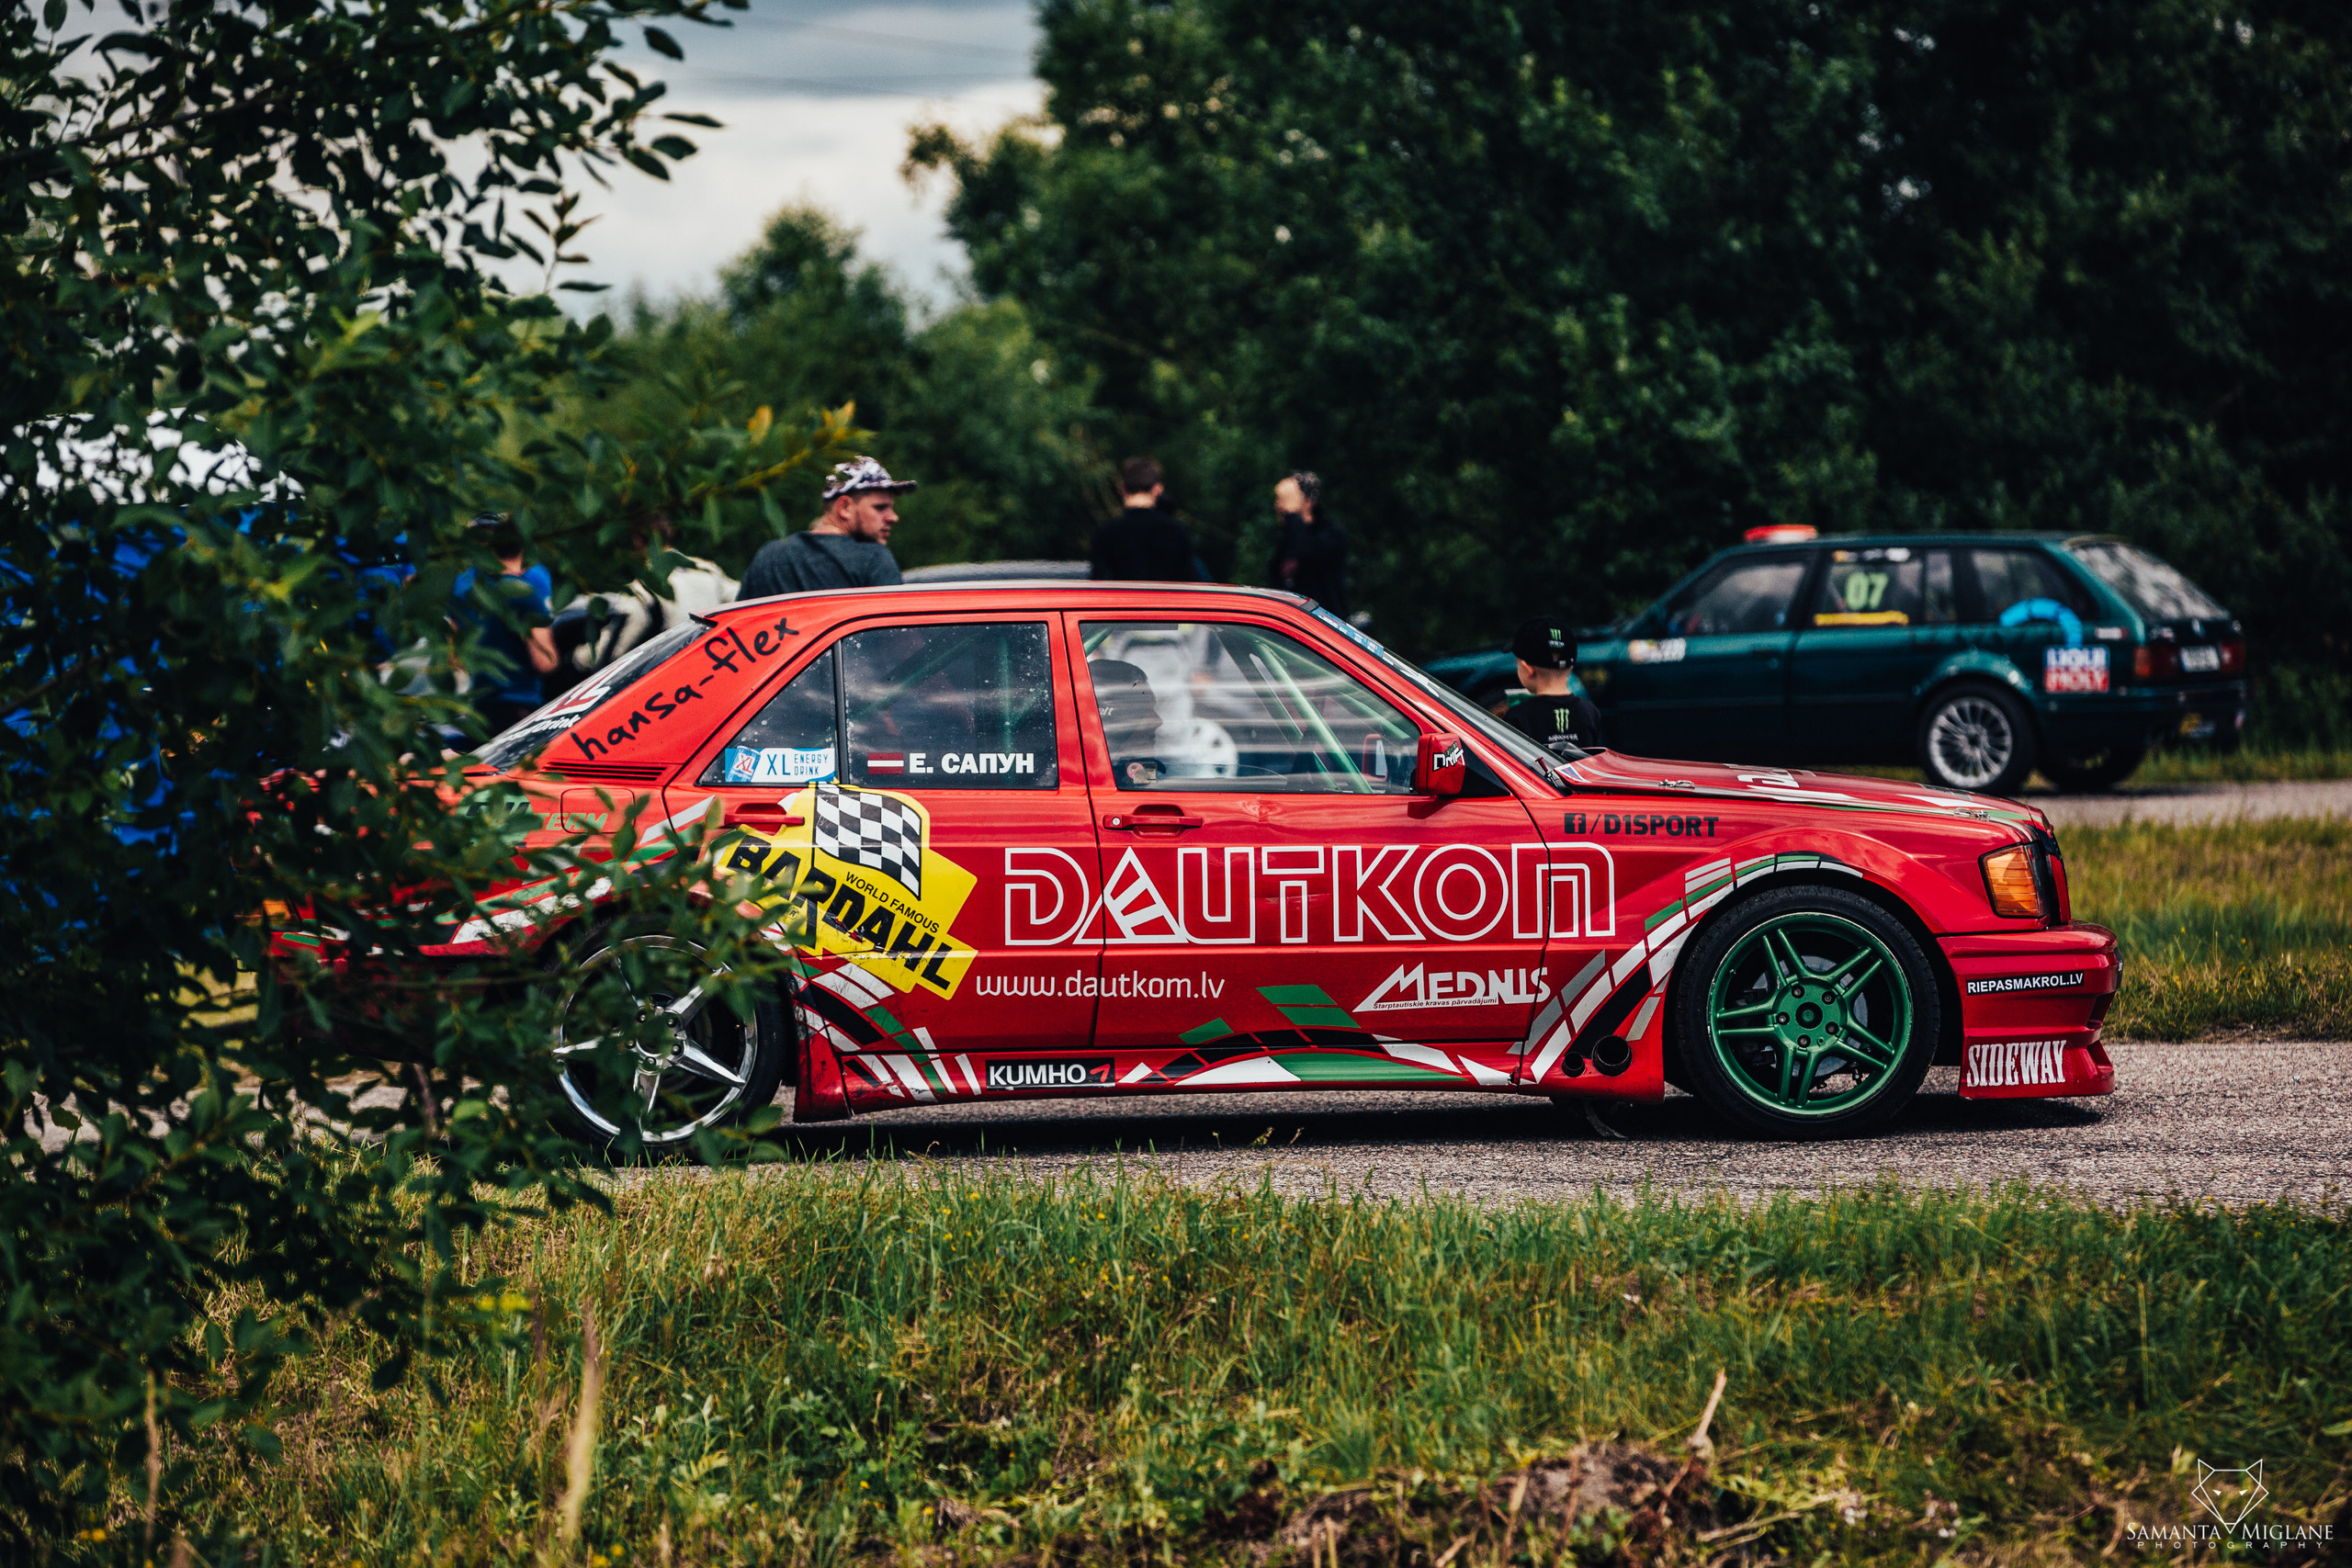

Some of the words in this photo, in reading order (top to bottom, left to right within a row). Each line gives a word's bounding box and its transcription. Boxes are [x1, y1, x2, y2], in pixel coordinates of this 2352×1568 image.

[1846, 571, 1888, 610] 07
[570, 617, 799, 761] hansa-flex
[766, 753, 791, 776] XL
[794, 753, 828, 764] ENERGY
[794, 765, 820, 776] DRINK
[941, 752, 1035, 773] САПУН
[845, 871, 889, 903] WORLD
[889, 898, 940, 933] FAMOUS
[976, 969, 1226, 999] www.dautkom.lv
[1351, 962, 1552, 1013] MEDNIS
[1966, 972, 2085, 994] RIEPASMAKROL.LV
[1373, 1000, 1424, 1010] Starptautiskie
[989, 1063, 1087, 1087] KUMHO
[1966, 1039, 2067, 1088] SIDEWAY
